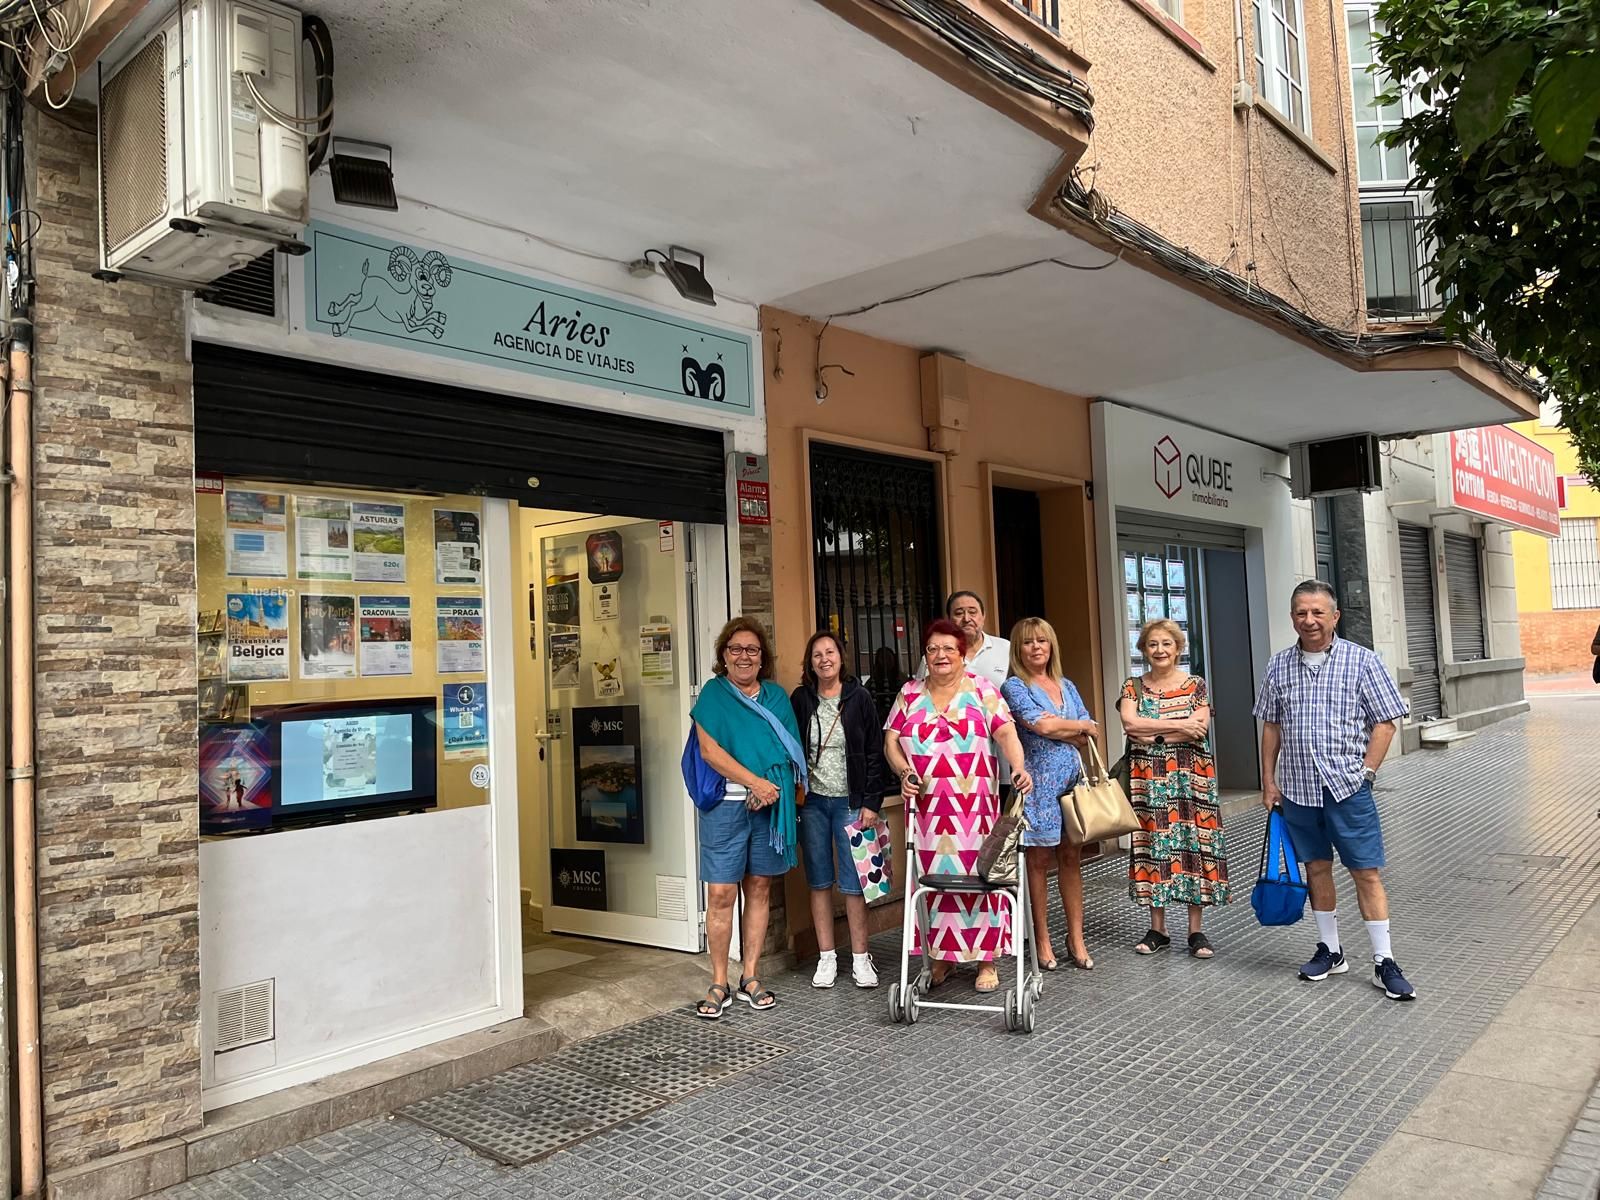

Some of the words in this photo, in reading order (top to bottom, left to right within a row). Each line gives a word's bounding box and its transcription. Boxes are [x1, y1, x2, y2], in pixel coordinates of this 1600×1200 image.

[522, 300, 610, 348] Aries
[493, 331, 562, 360] AGENCIA
[565, 347, 584, 364] DE
[587, 351, 635, 375] VIAJES
[1185, 453, 1233, 492] QUBE
[1480, 427, 1557, 504] ALIMENTACION
[740, 482, 767, 495] Alarma
[1455, 468, 1486, 501] FORTUNA
[1191, 490, 1229, 509] inmobiliaria
[359, 515, 398, 525] ASTURIAS
[304, 606, 328, 619] Harry
[452, 609, 479, 617] PRAGA
[232, 645, 285, 658] Belgica
[603, 720, 624, 731] MSC
[572, 870, 601, 885] MSC
